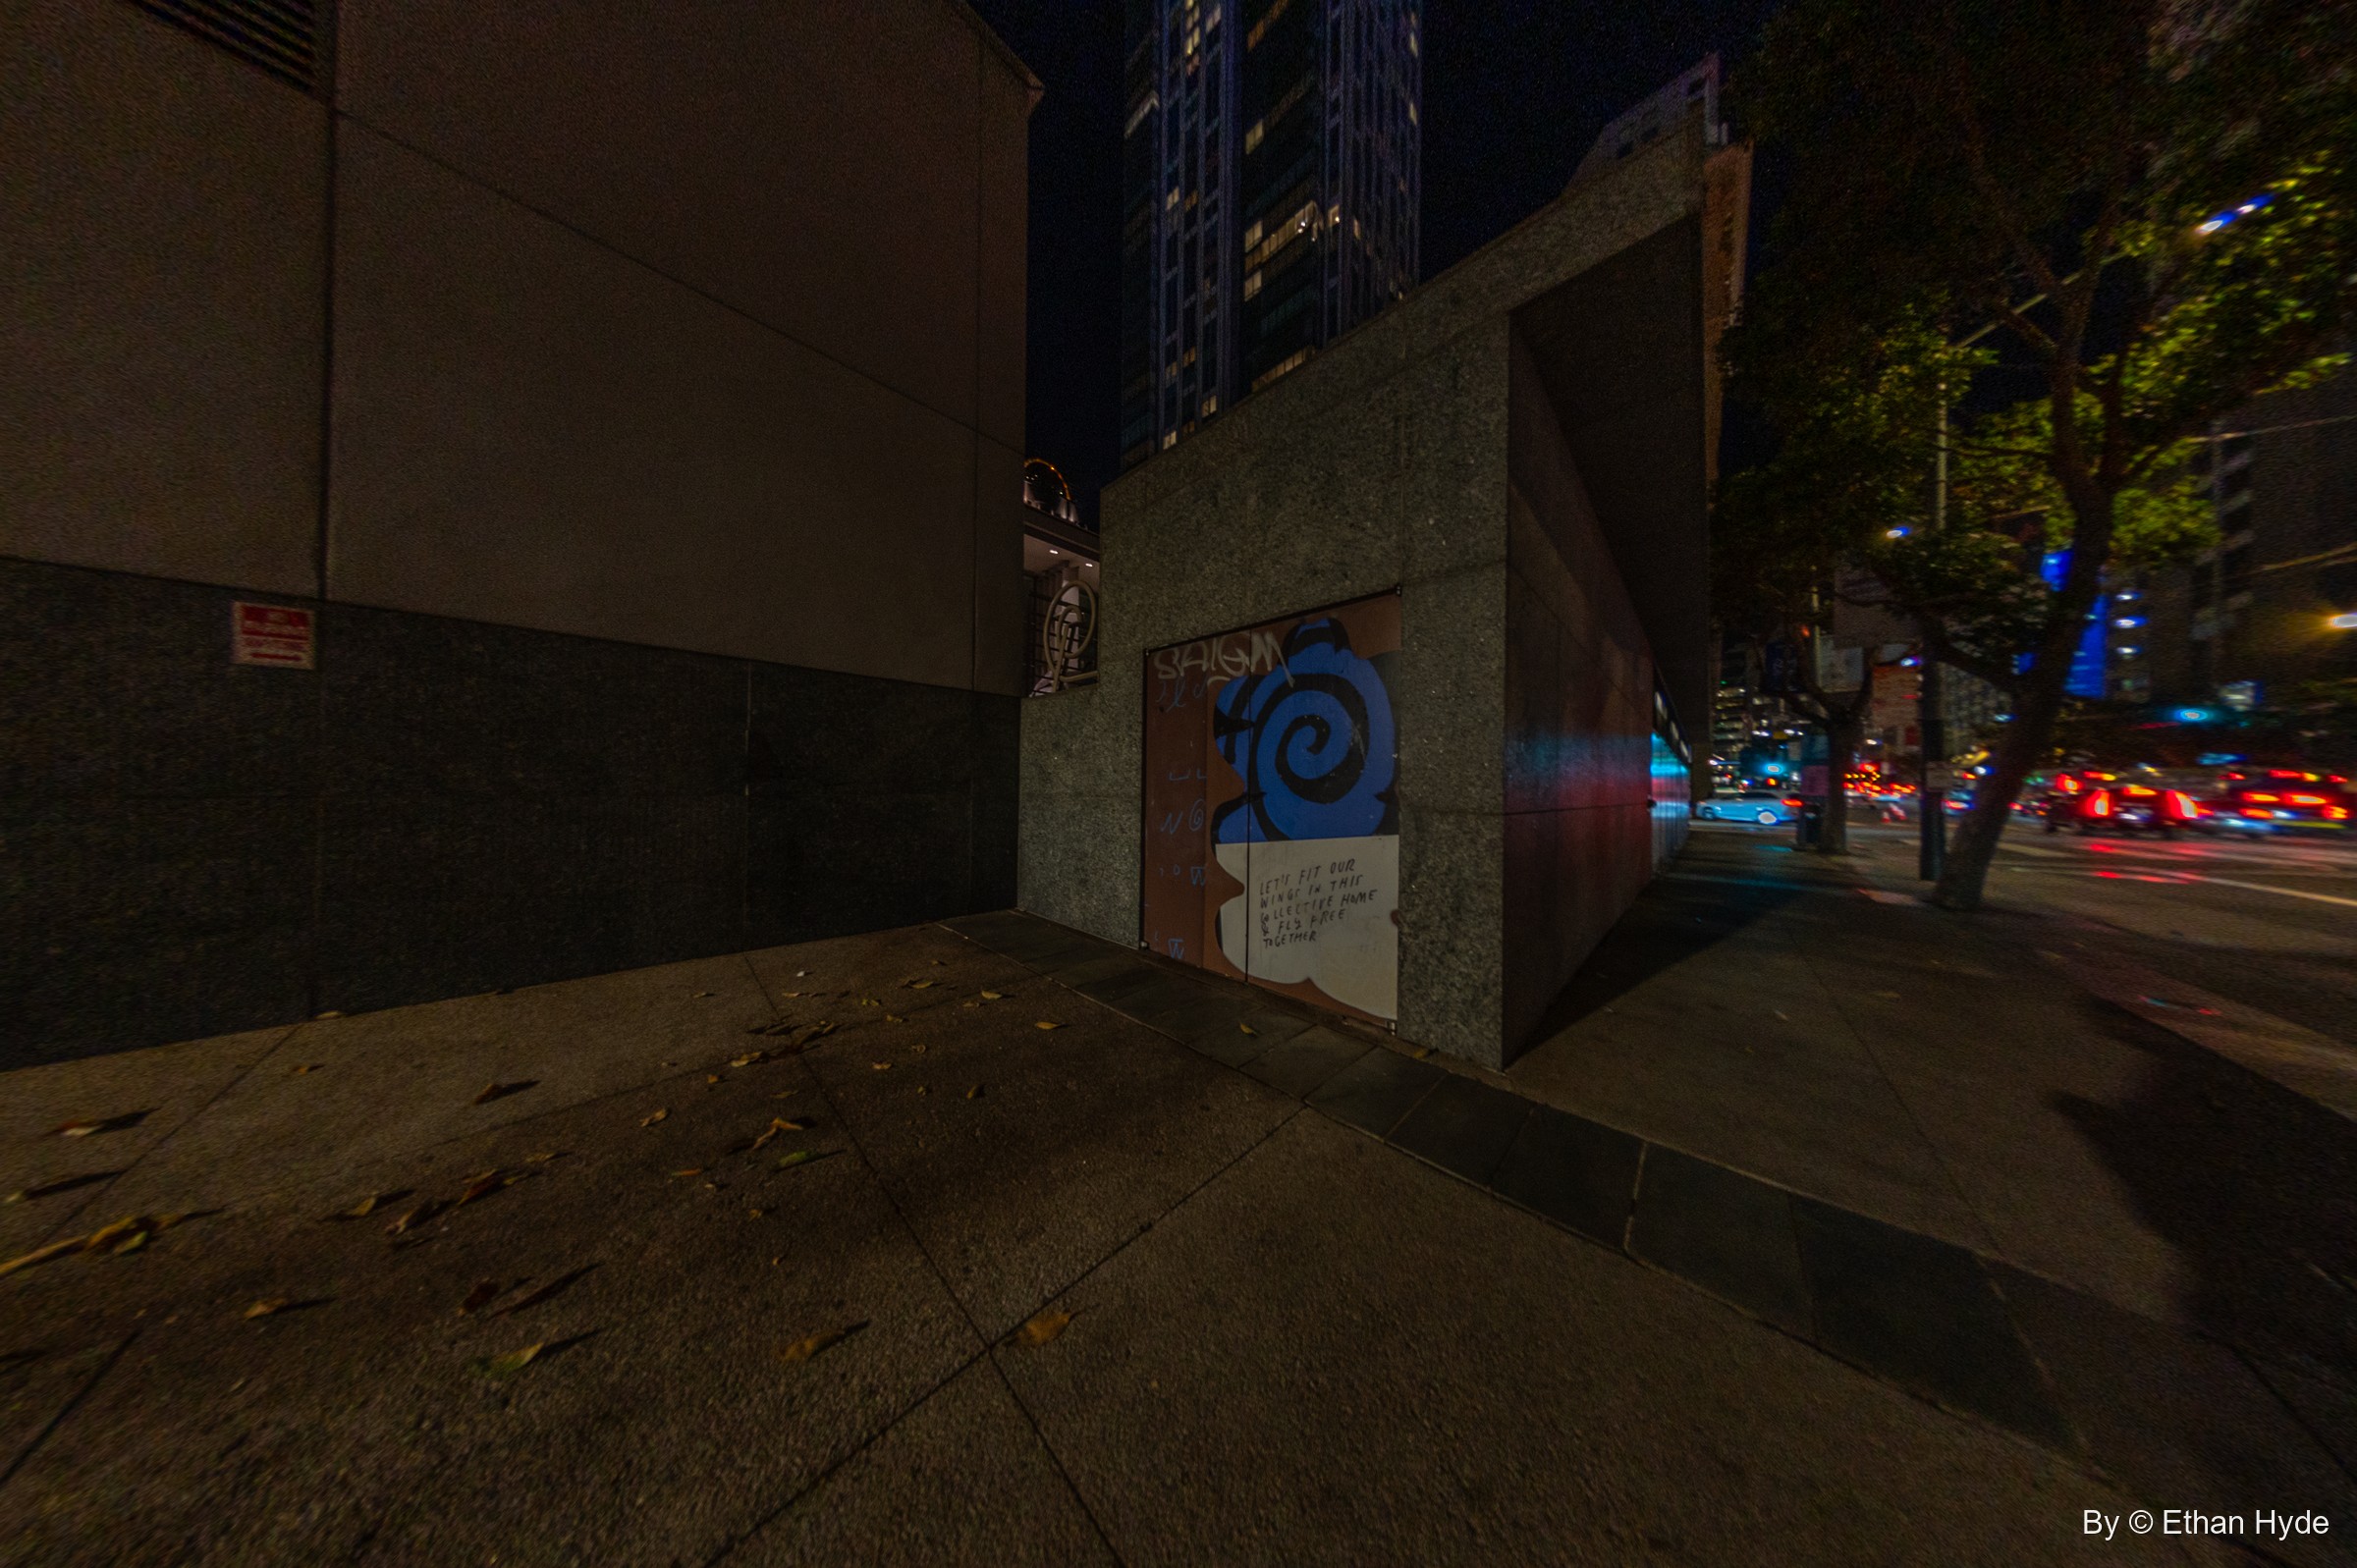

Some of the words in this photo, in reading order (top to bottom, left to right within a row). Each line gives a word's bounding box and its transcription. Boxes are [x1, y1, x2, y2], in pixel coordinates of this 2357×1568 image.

[1260, 873, 1290, 895] LET'S
[1299, 865, 1322, 886] FIT
[1330, 858, 1356, 875] OUR
[1260, 888, 1301, 909] WINGS
[1308, 883, 1322, 896] IN
[1330, 874, 1364, 892] THIS
[1341, 889, 1379, 907] HOME
[1278, 917, 1302, 936] FLY
[1309, 908, 1346, 929] FREE
[1263, 930, 1317, 949] TOGETHER
